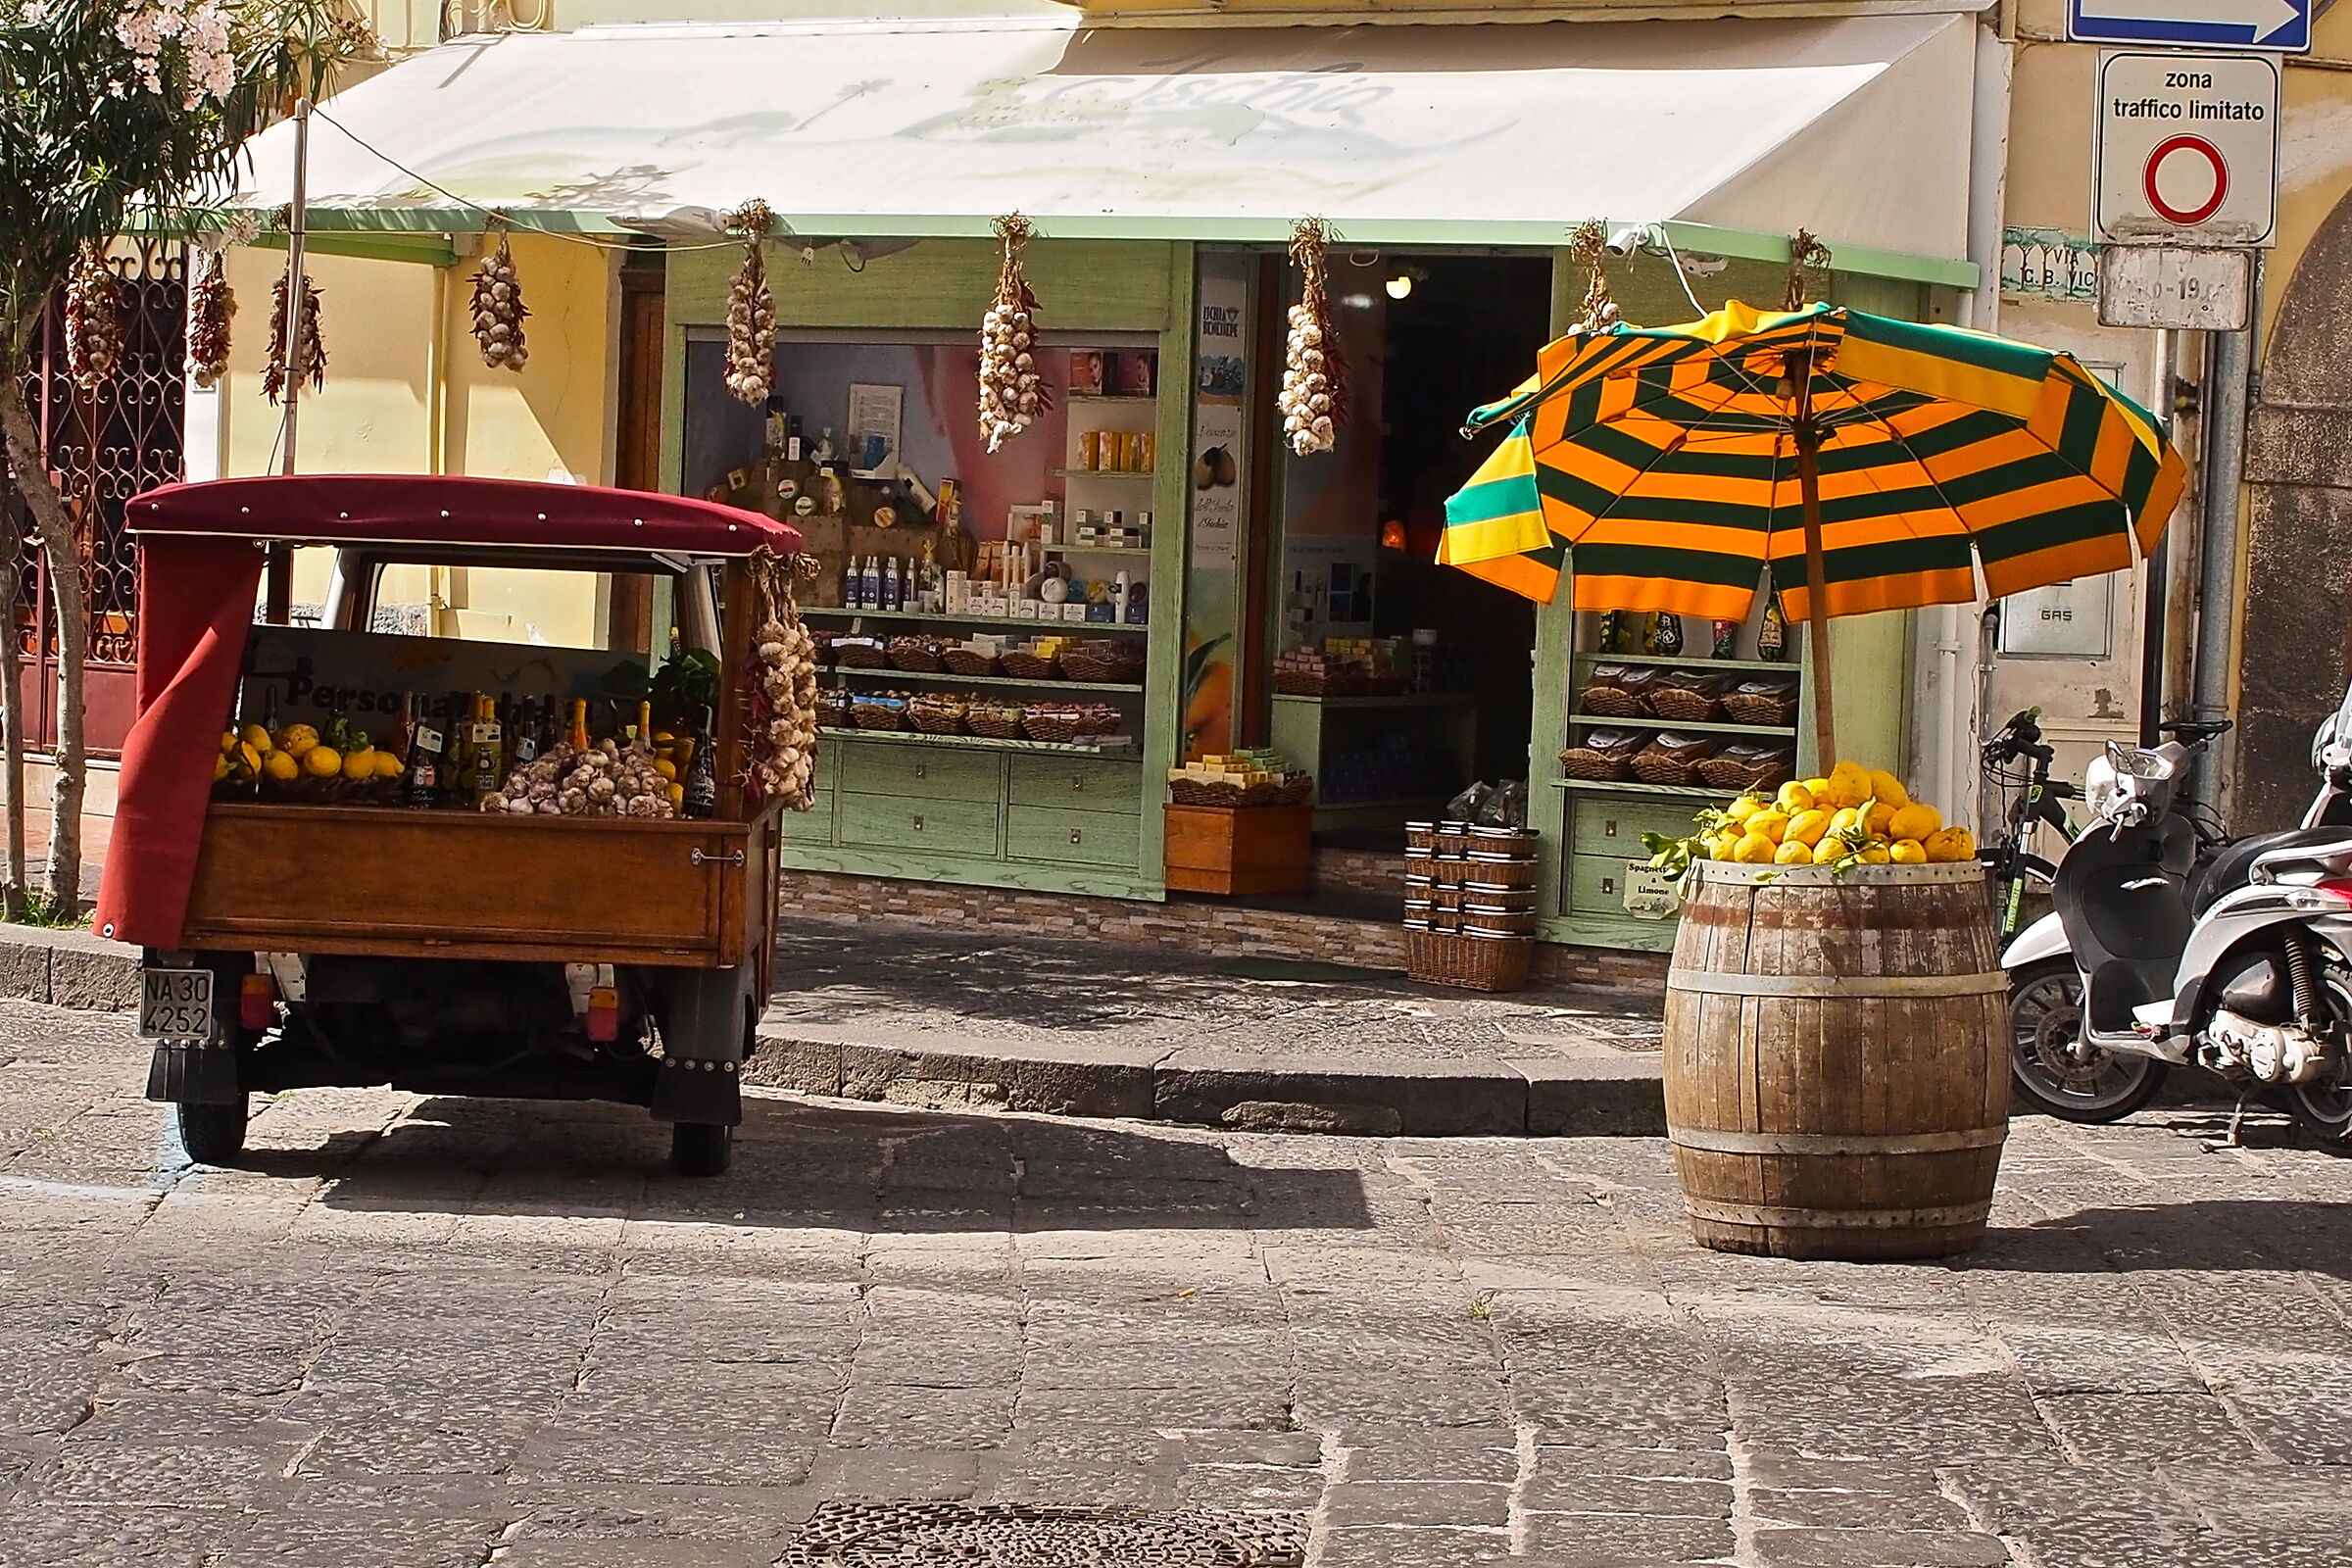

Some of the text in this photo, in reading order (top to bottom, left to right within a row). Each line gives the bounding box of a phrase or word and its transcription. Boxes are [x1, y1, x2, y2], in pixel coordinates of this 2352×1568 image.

[2165, 71, 2213, 89] zona
[2113, 98, 2265, 121] traffico limitato
[2054, 249, 2080, 266] VIA
[2069, 270, 2094, 286] VIC
[2040, 610, 2073, 621] GAS
[1638, 885, 1669, 895] Limone
[146, 972, 209, 1003] NA 30
[144, 1006, 208, 1034] 4252
